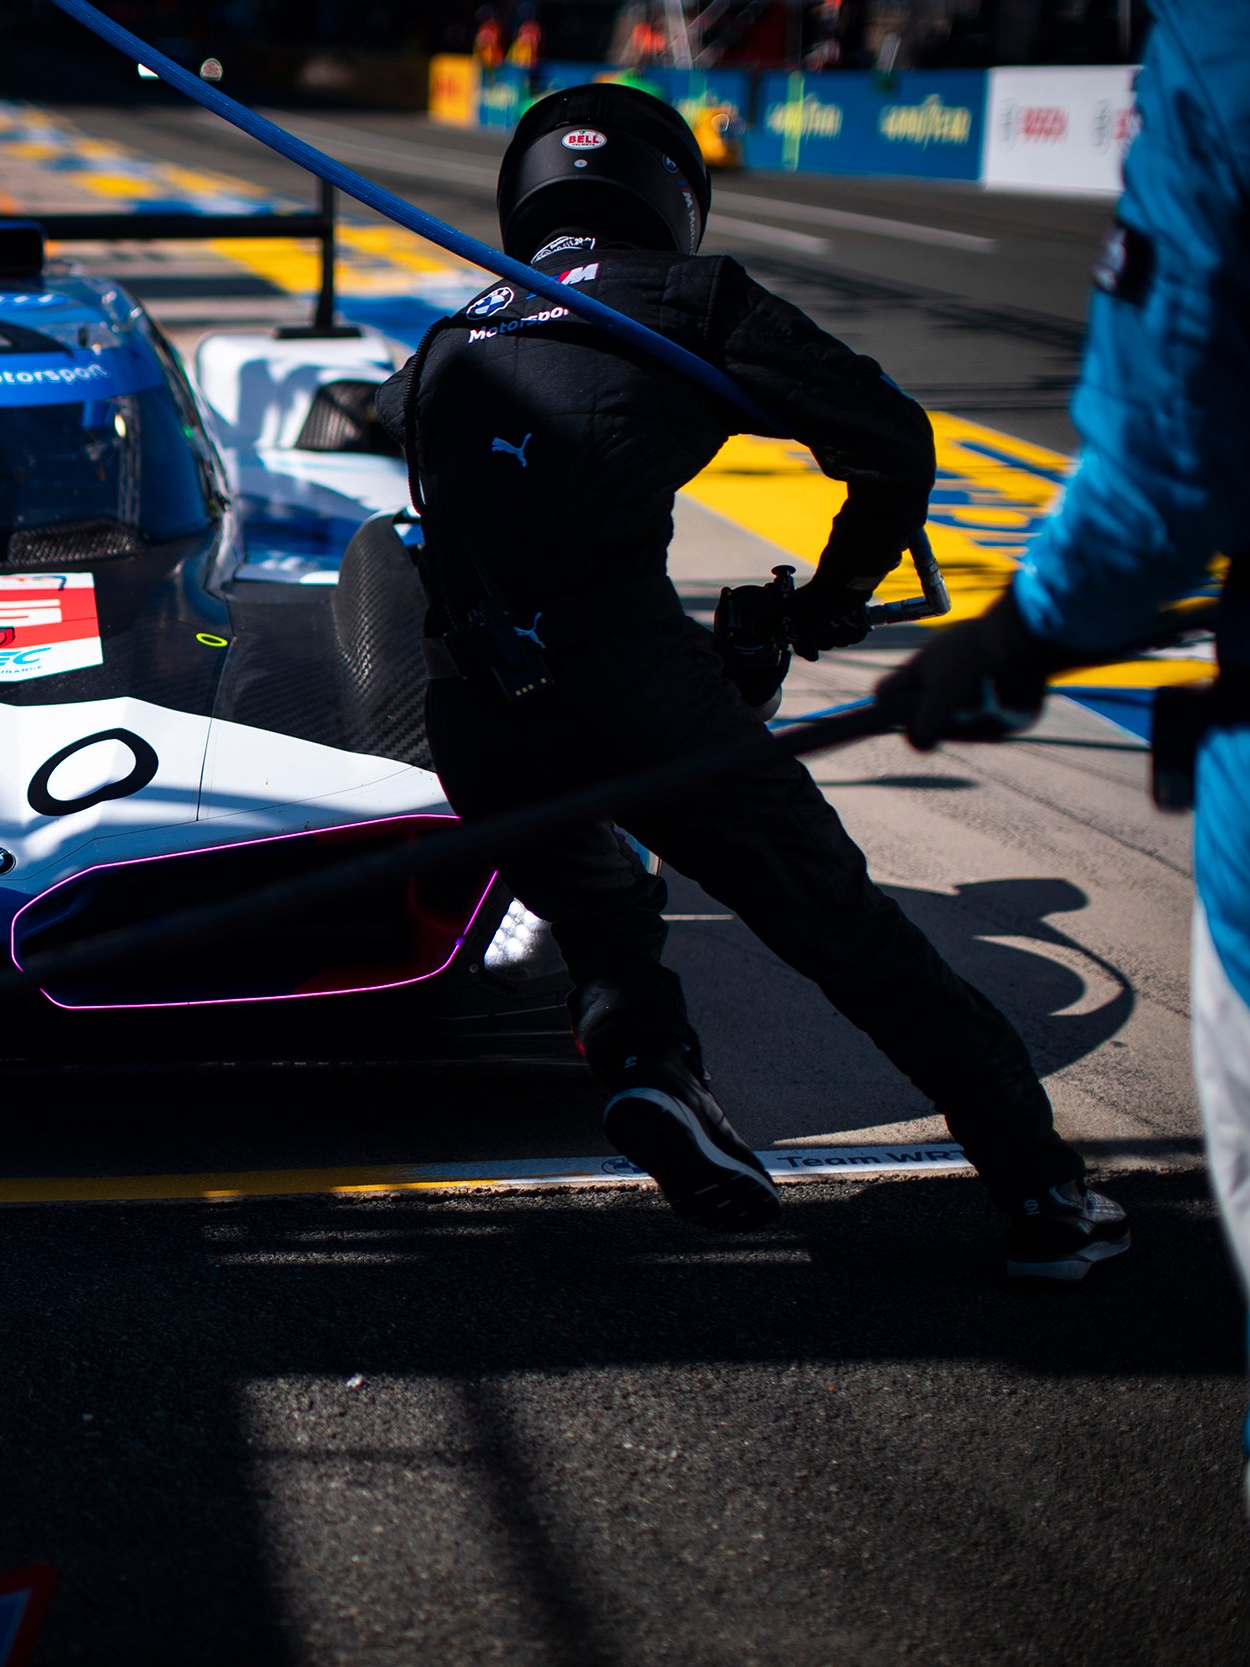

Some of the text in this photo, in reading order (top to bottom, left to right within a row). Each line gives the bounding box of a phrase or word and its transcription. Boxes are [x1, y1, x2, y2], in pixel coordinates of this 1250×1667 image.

[568, 135, 599, 144] BELL
[468, 306, 570, 344] Motorspo
[777, 1154, 882, 1168] Team
